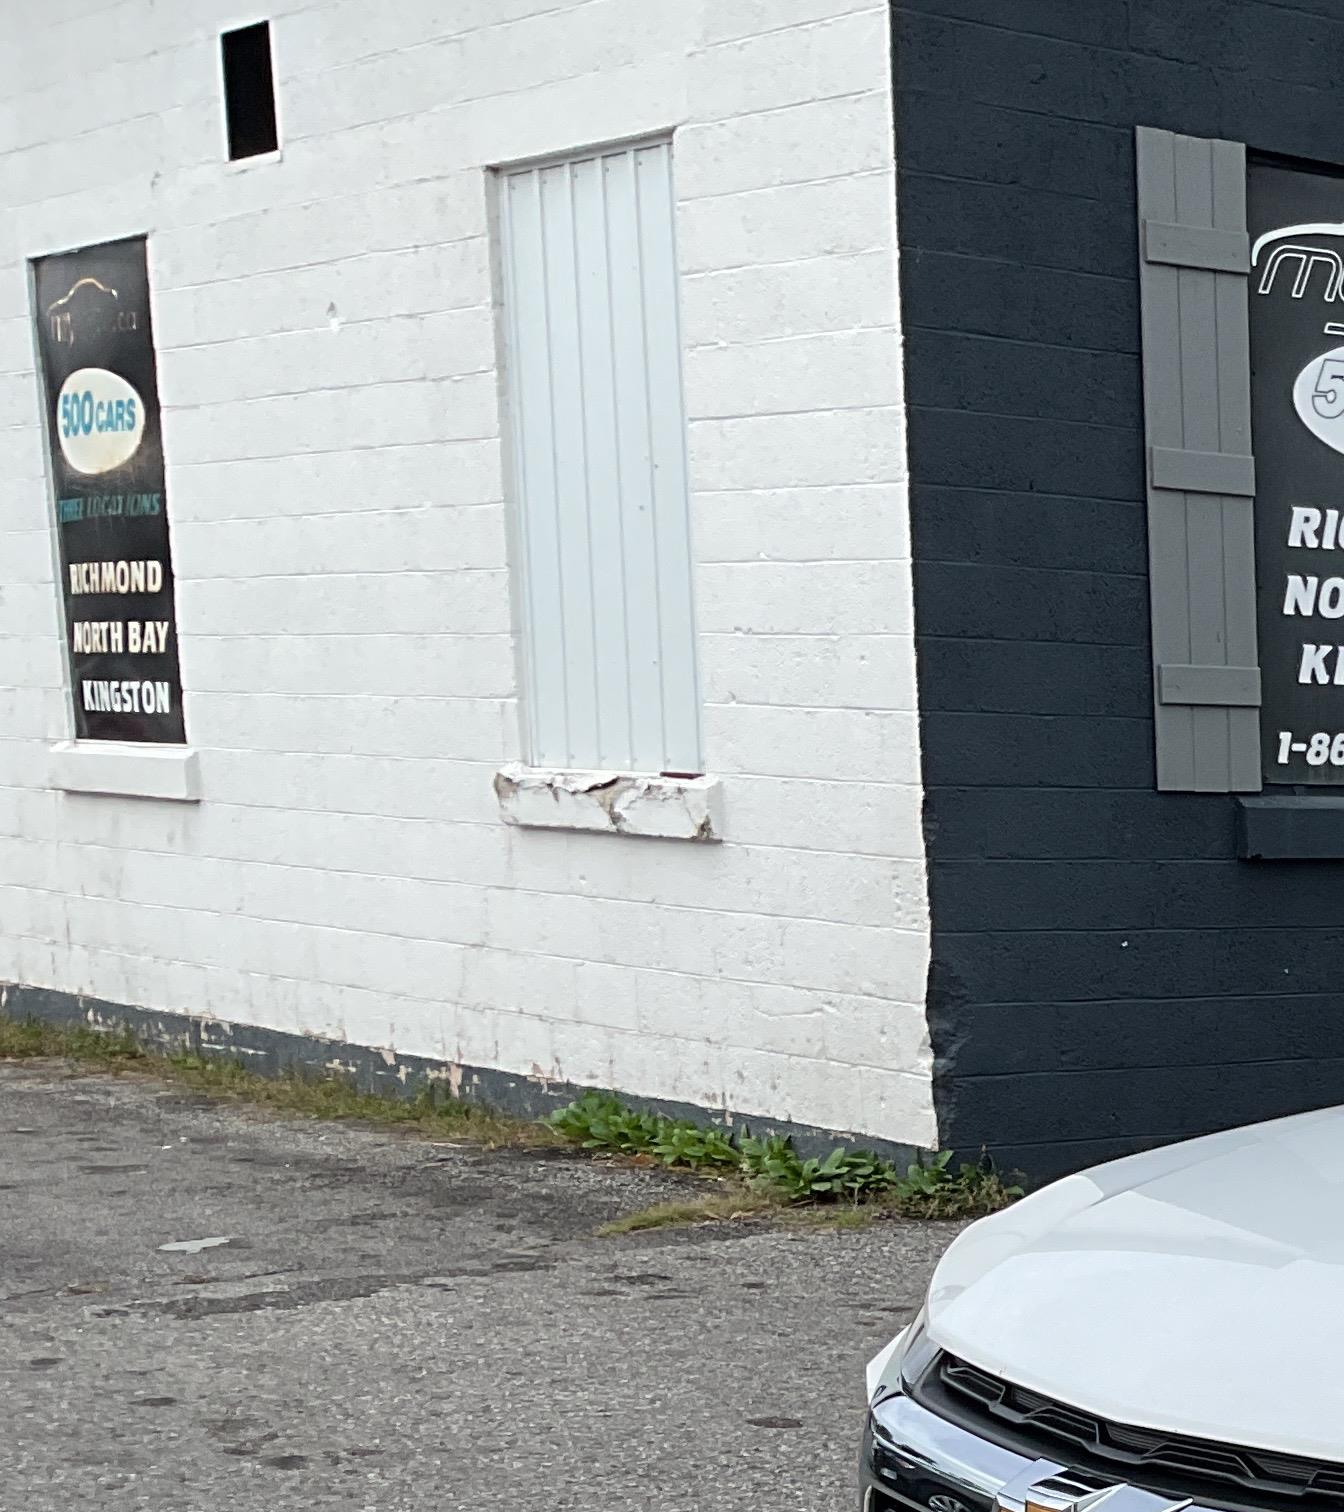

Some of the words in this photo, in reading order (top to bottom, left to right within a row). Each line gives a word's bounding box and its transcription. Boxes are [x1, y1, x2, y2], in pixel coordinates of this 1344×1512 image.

[62, 390, 94, 438] 500
[95, 398, 136, 433] CARS
[69, 560, 162, 594] RICHMOND
[73, 621, 123, 654] NORTH
[127, 621, 169, 654] BAY
[82, 680, 170, 714] KINGSTON
